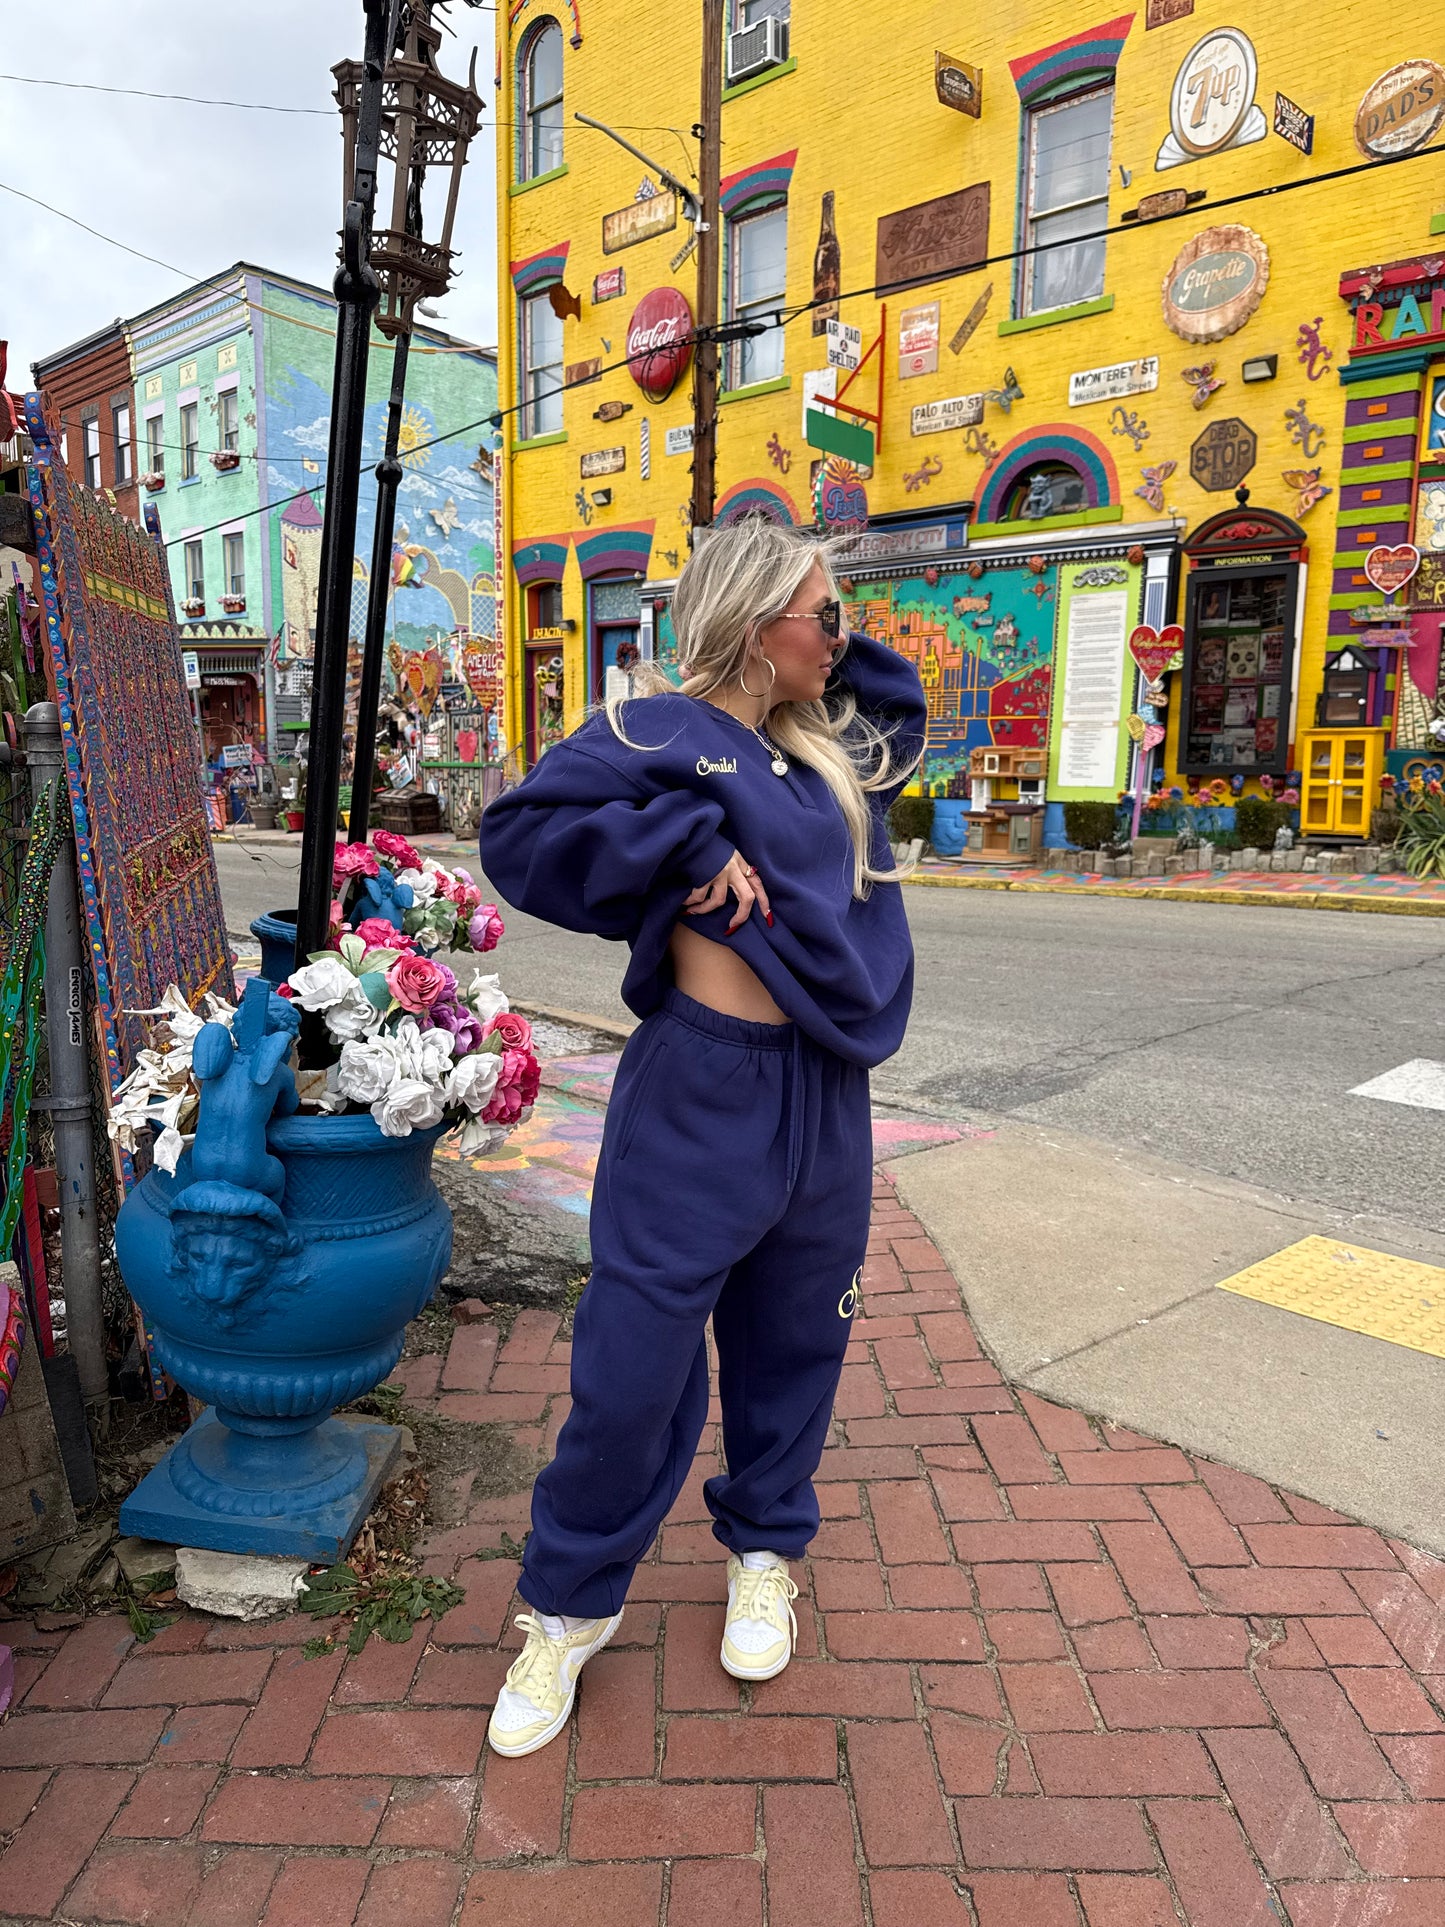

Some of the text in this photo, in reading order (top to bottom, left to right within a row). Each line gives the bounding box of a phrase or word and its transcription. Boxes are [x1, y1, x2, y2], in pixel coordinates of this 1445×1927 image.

[1366, 77, 1434, 139] DAD'S
[828, 321, 860, 344] AIR RAID
[829, 349, 858, 370] SHELTER
[1074, 364, 1136, 388] MONTEREY
[914, 405, 938, 420] PALO
[941, 400, 963, 414] ALTO
[1195, 439, 1251, 472] STOP
[916, 528, 945, 545] CITY
[1213, 554, 1273, 567] INFORMATION
[495, 600, 504, 670] WELCOME
[496, 678, 504, 728] HOUSE
[696, 755, 738, 776] Smile!
[68, 968, 81, 1045] ENRICO JAMES
